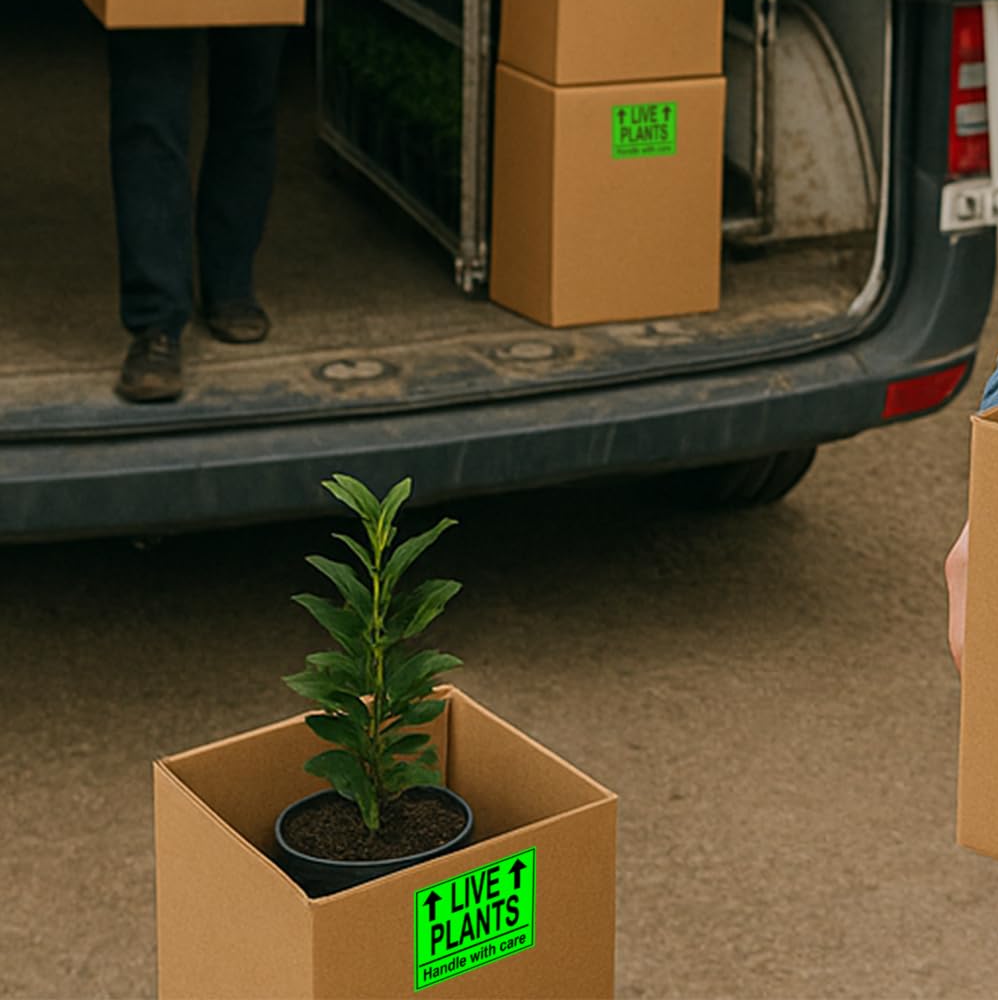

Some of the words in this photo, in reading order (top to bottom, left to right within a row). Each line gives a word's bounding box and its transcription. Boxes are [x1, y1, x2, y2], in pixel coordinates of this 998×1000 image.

[620, 124, 668, 142] PLANTS
[631, 104, 657, 124] LIVE
[451, 865, 500, 913] LIVE
[431, 894, 520, 956] PLANTS
[423, 956, 467, 983] Handle
[470, 944, 496, 963] with
[499, 933, 526, 952] care
